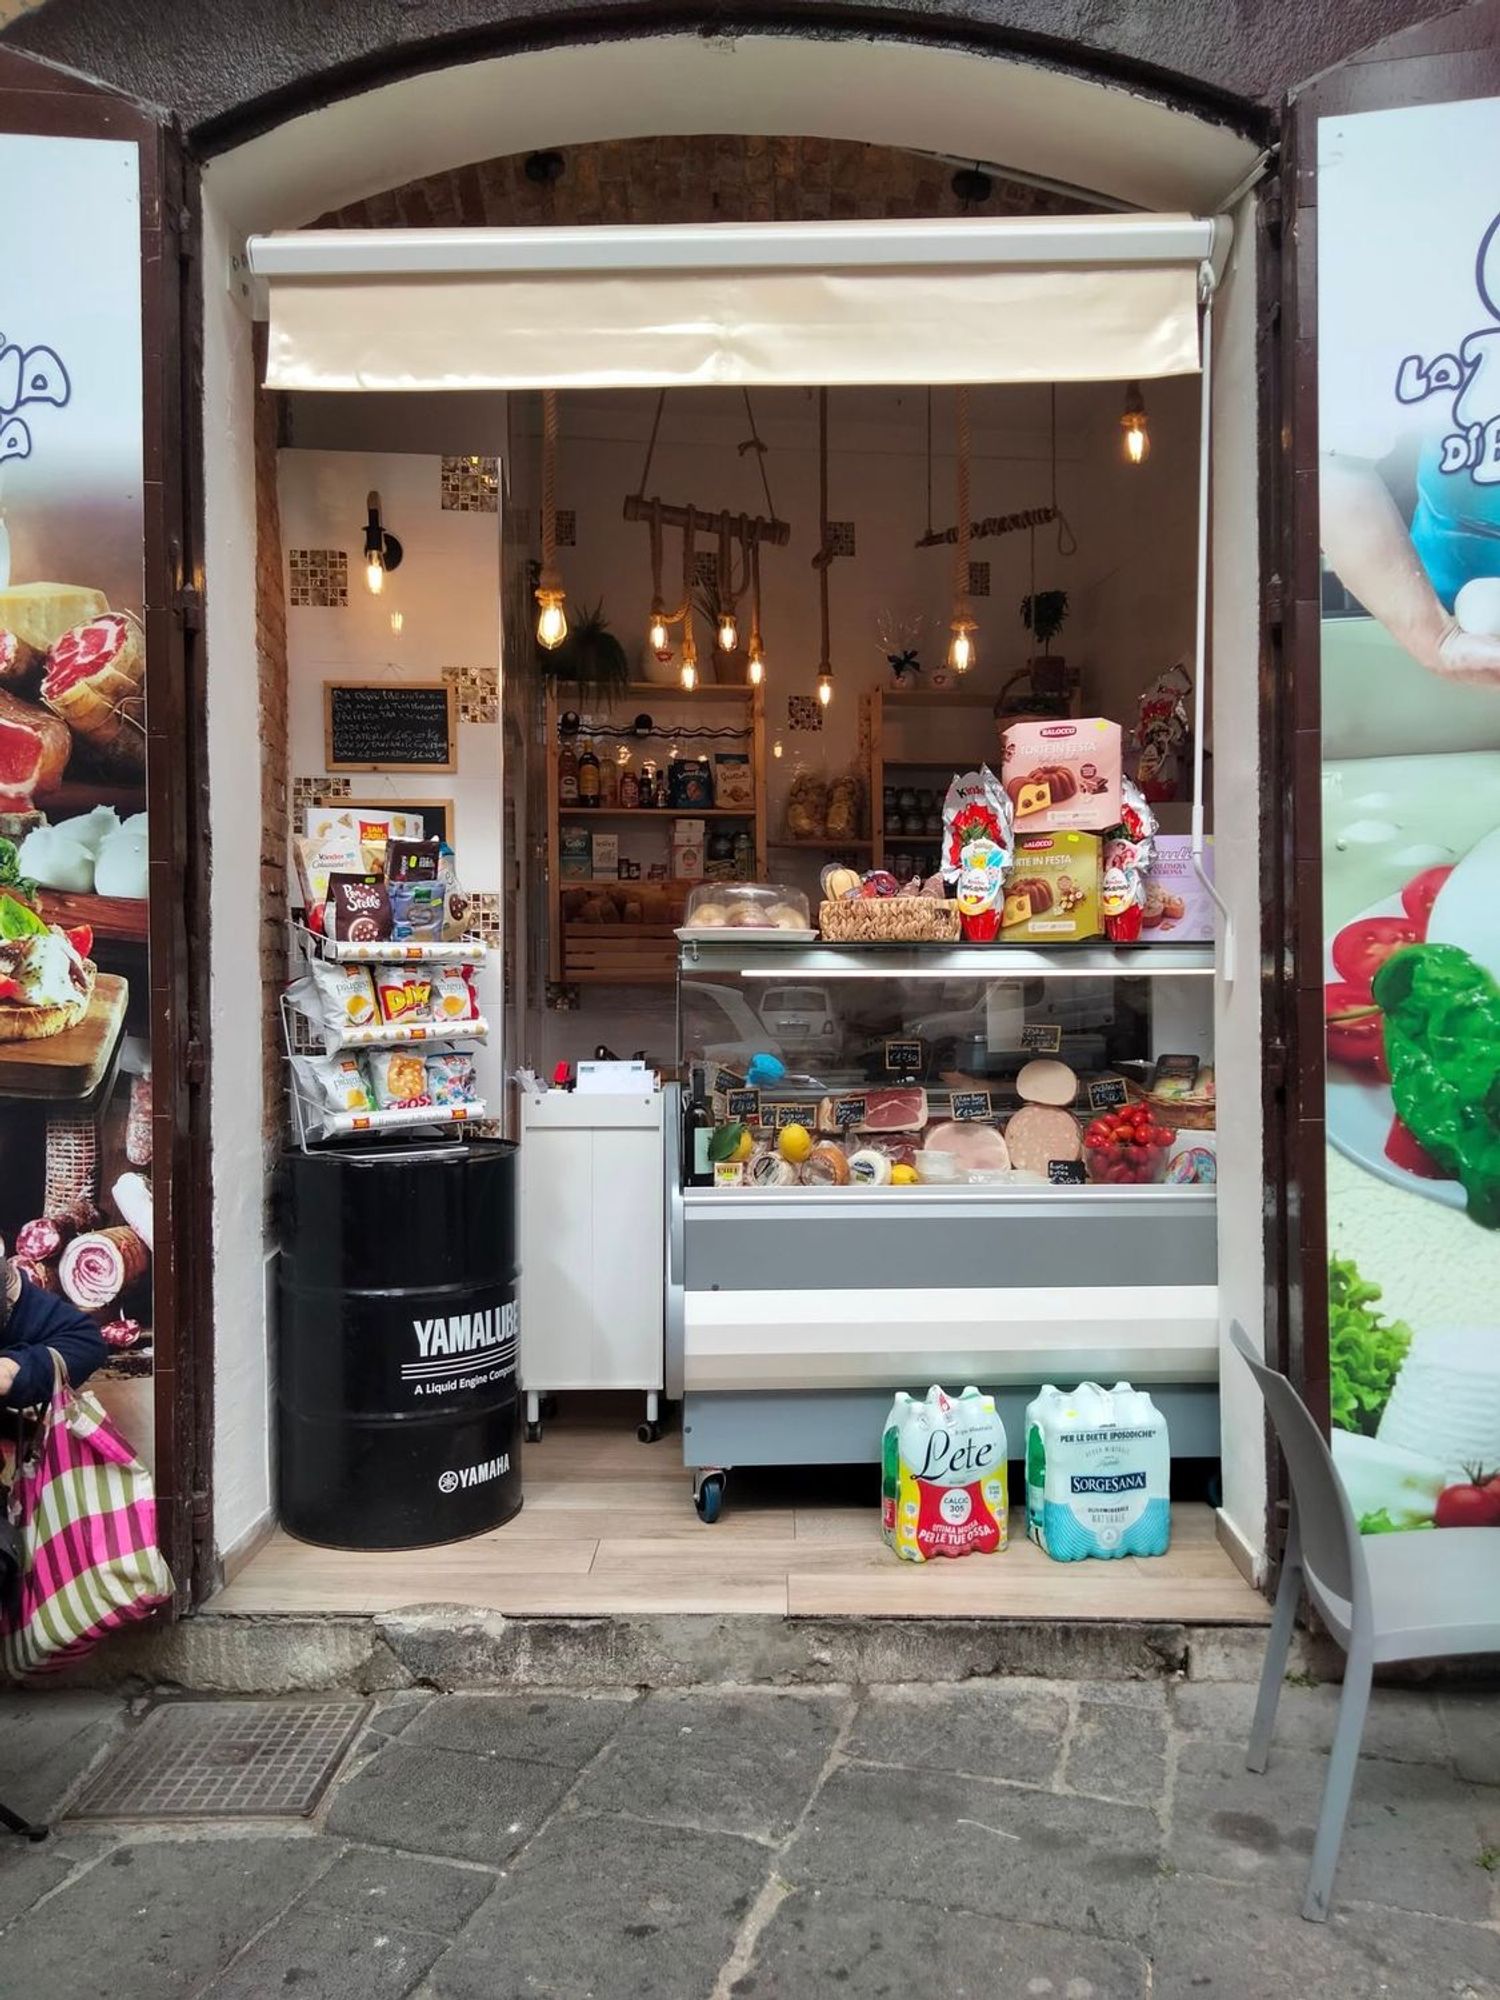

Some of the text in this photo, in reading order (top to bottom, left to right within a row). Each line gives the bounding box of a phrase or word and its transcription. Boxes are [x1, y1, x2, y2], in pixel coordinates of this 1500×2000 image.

[1041, 727, 1076, 736] BALOCCO
[1045, 854, 1072, 865] FESTA
[414, 1384, 423, 1396] A
[426, 1378, 457, 1396] Liquid
[459, 1373, 488, 1389] Engine
[1060, 1434, 1075, 1443] PER
[1076, 1434, 1085, 1442] LE
[1086, 1433, 1108, 1442] DIETE
[910, 1429, 993, 1480] Lete
[459, 1453, 511, 1488] YAMAHA
[949, 1504, 964, 1513] 305
[918, 1529, 935, 1543] PER
[935, 1533, 946, 1544] LE
[948, 1534, 966, 1545] TUE
